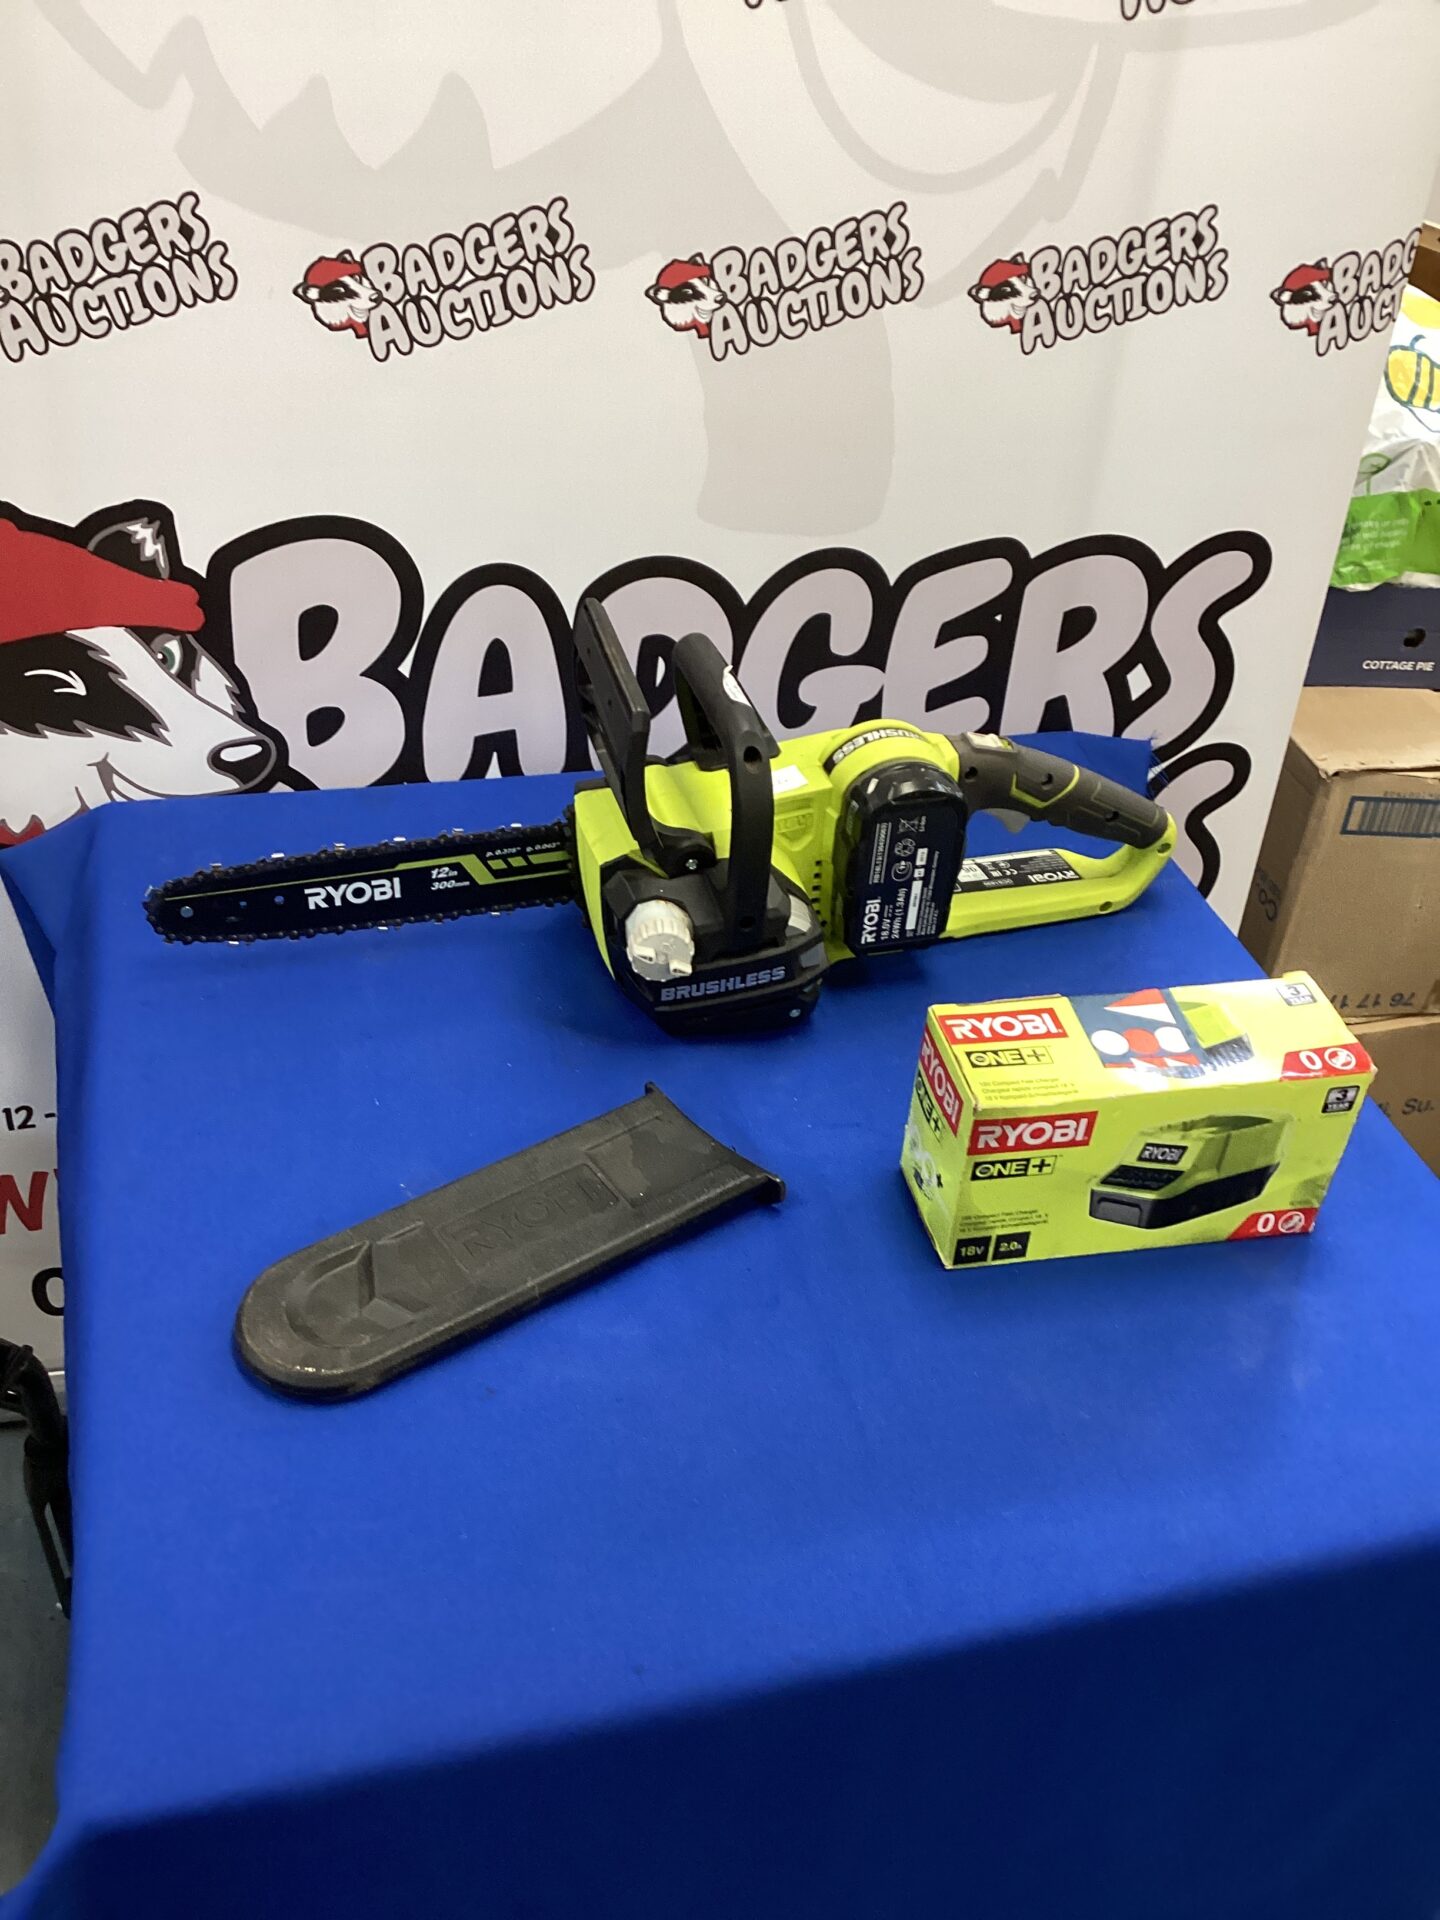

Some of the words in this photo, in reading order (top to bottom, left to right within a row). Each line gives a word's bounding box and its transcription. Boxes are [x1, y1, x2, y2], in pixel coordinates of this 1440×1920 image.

[0, 191, 209, 300] BADGERS
[362, 196, 574, 302] BADGERS
[711, 201, 910, 305] BADGERS
[1029, 205, 1219, 300] BADGERS
[1332, 227, 1422, 305] BADG
[0, 242, 238, 362] AUCTIONS
[367, 245, 595, 361] AUCTIONS
[709, 246, 924, 361] AUCTIONS
[1020, 249, 1228, 354] AUCTIONS
[1316, 275, 1408, 357] AUCT
[205, 515, 1272, 788] BADGERS
[1362, 660, 1415, 671] COTTAGE
[1416, 661, 1435, 672] PIE
[304, 877, 402, 911] RYOBI
[430, 880, 470, 891] 300mm
[1027, 868, 1079, 884] RYOBI
[861, 898, 881, 944] RYOBI
[661, 965, 786, 1002] BRUSHLESS
[945, 1014, 1059, 1040] RYOBI
[921, 1031, 960, 1125] RYOBI
[1299, 1050, 1323, 1070] 0
[1335, 1089, 1348, 1101] 3
[2, 1105, 36, 1131] 12
[977, 1117, 1087, 1149] RYOBI
[1141, 1146, 1183, 1161] RYOBI
[1257, 1213, 1275, 1233] 0
[960, 1245, 985, 1257] 18V
